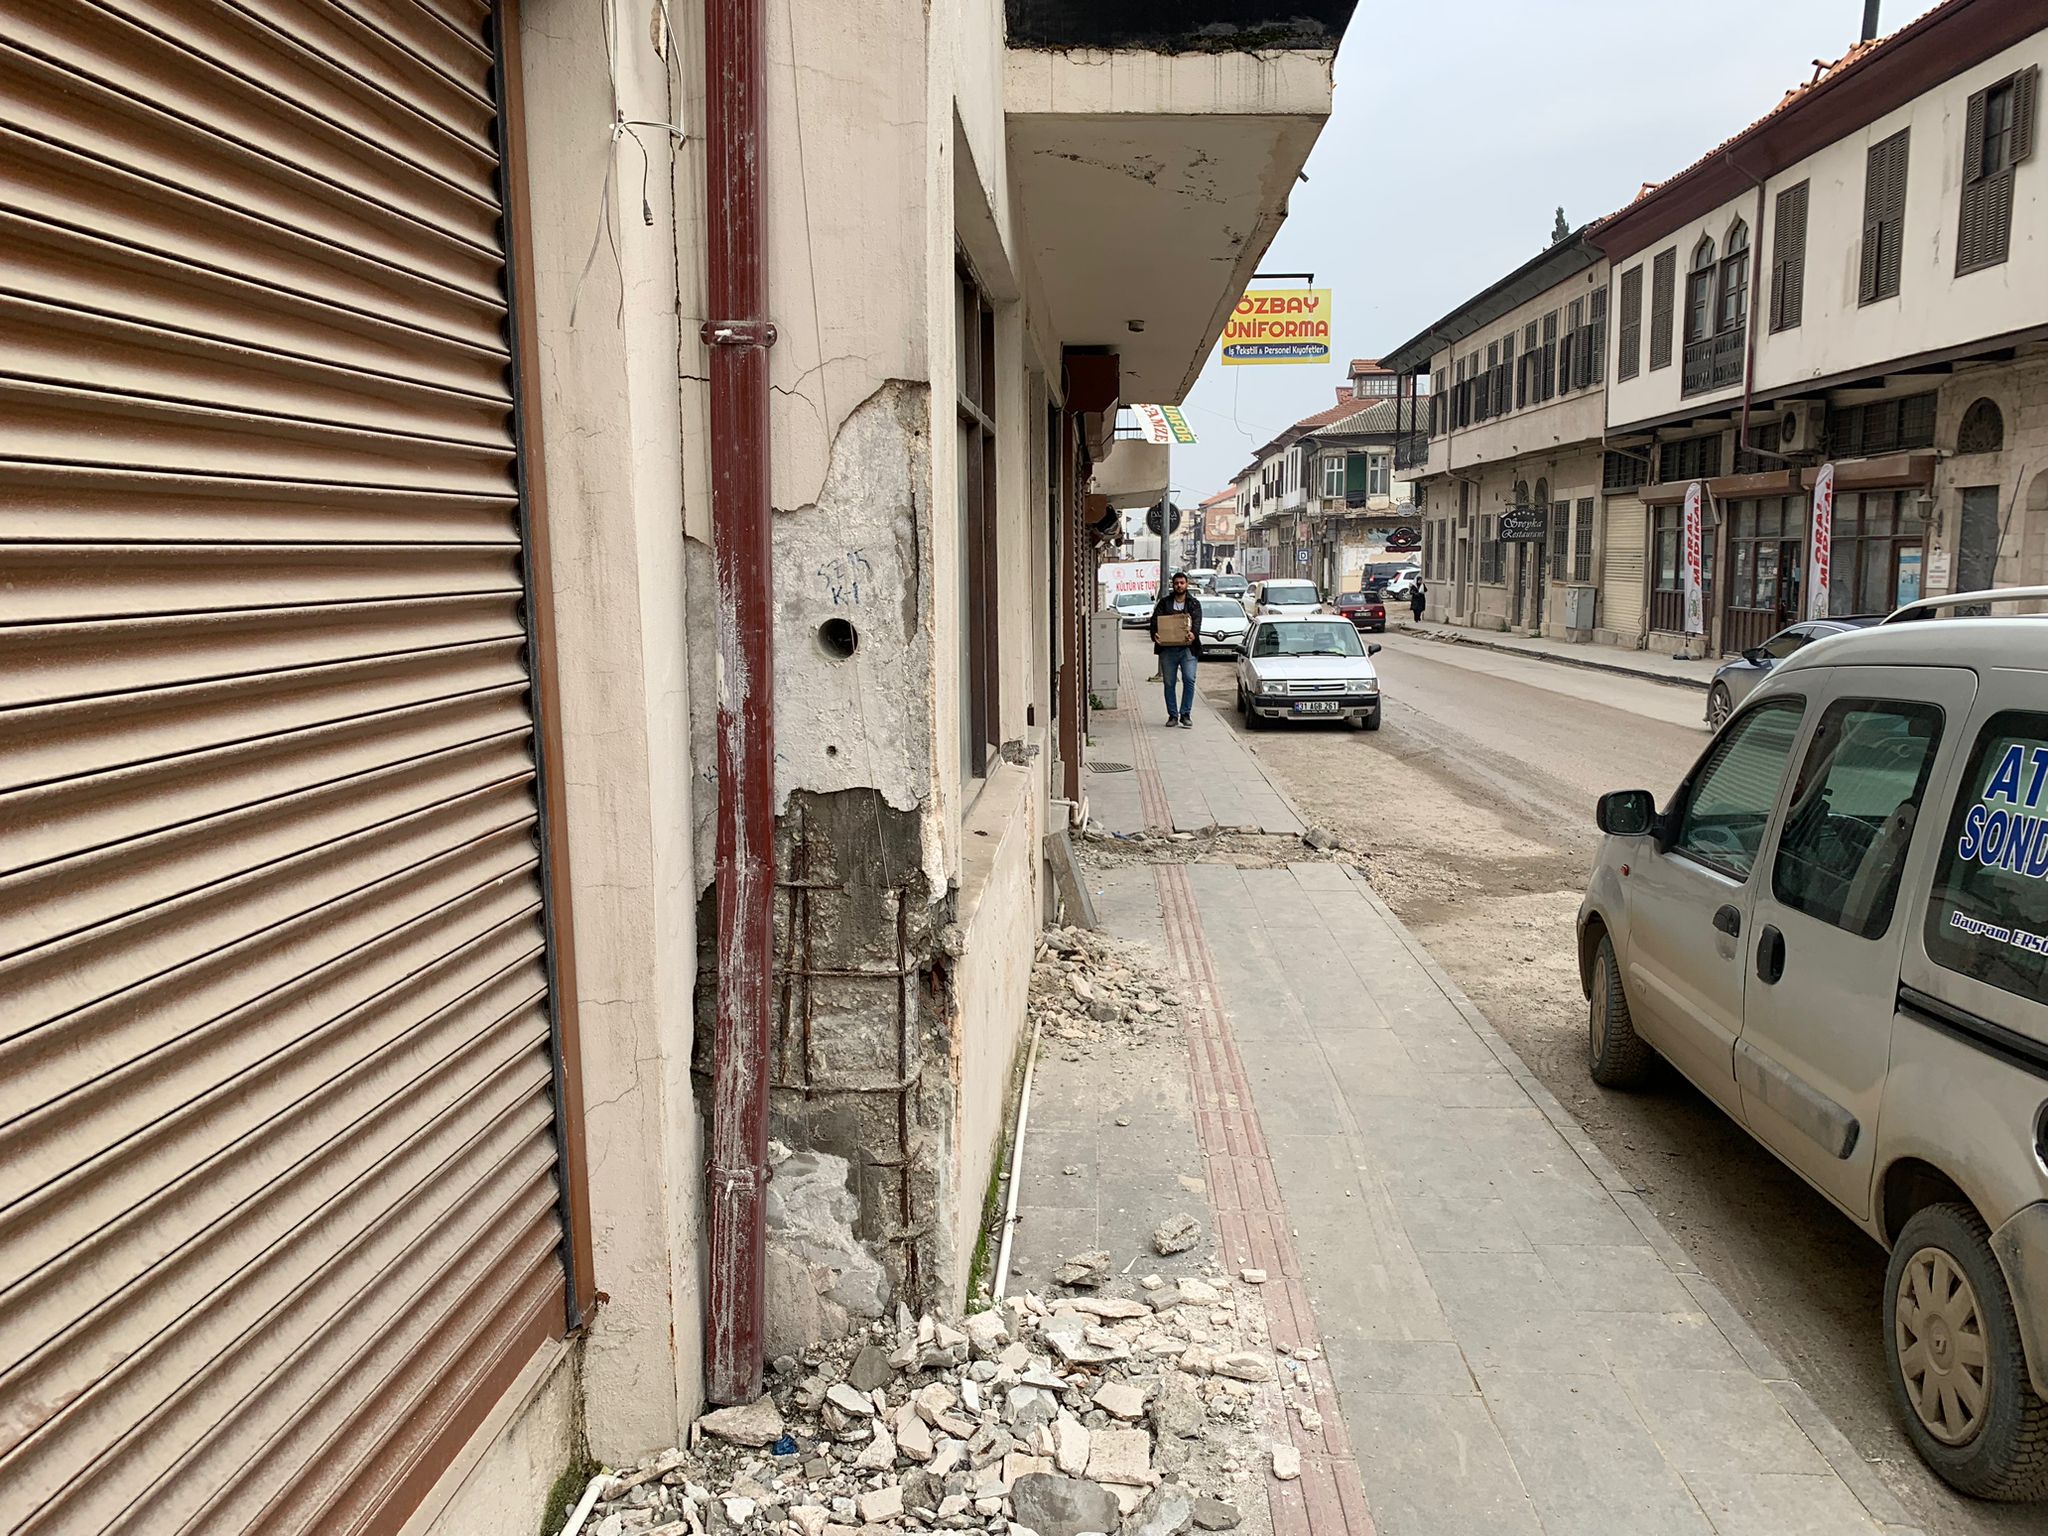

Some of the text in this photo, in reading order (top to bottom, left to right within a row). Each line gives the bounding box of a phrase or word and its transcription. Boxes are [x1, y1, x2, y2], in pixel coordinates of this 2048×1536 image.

[1235, 295, 1320, 315] ÖZBAY
[1224, 319, 1329, 338] ÜNİFORMA
[1236, 345, 1258, 355] Tekstili
[1264, 346, 1291, 355] Personel
[1292, 345, 1325, 356] Kıyafetleri
[1162, 405, 1193, 443] UAFÖR
[1501, 529, 1545, 539] Restaurant
[1115, 579, 1157, 592] KÜLTÜR VE TUR
[1982, 743, 2048, 809] AT
[1958, 803, 2048, 881] SOND
[1950, 910, 2010, 943] Bayram
